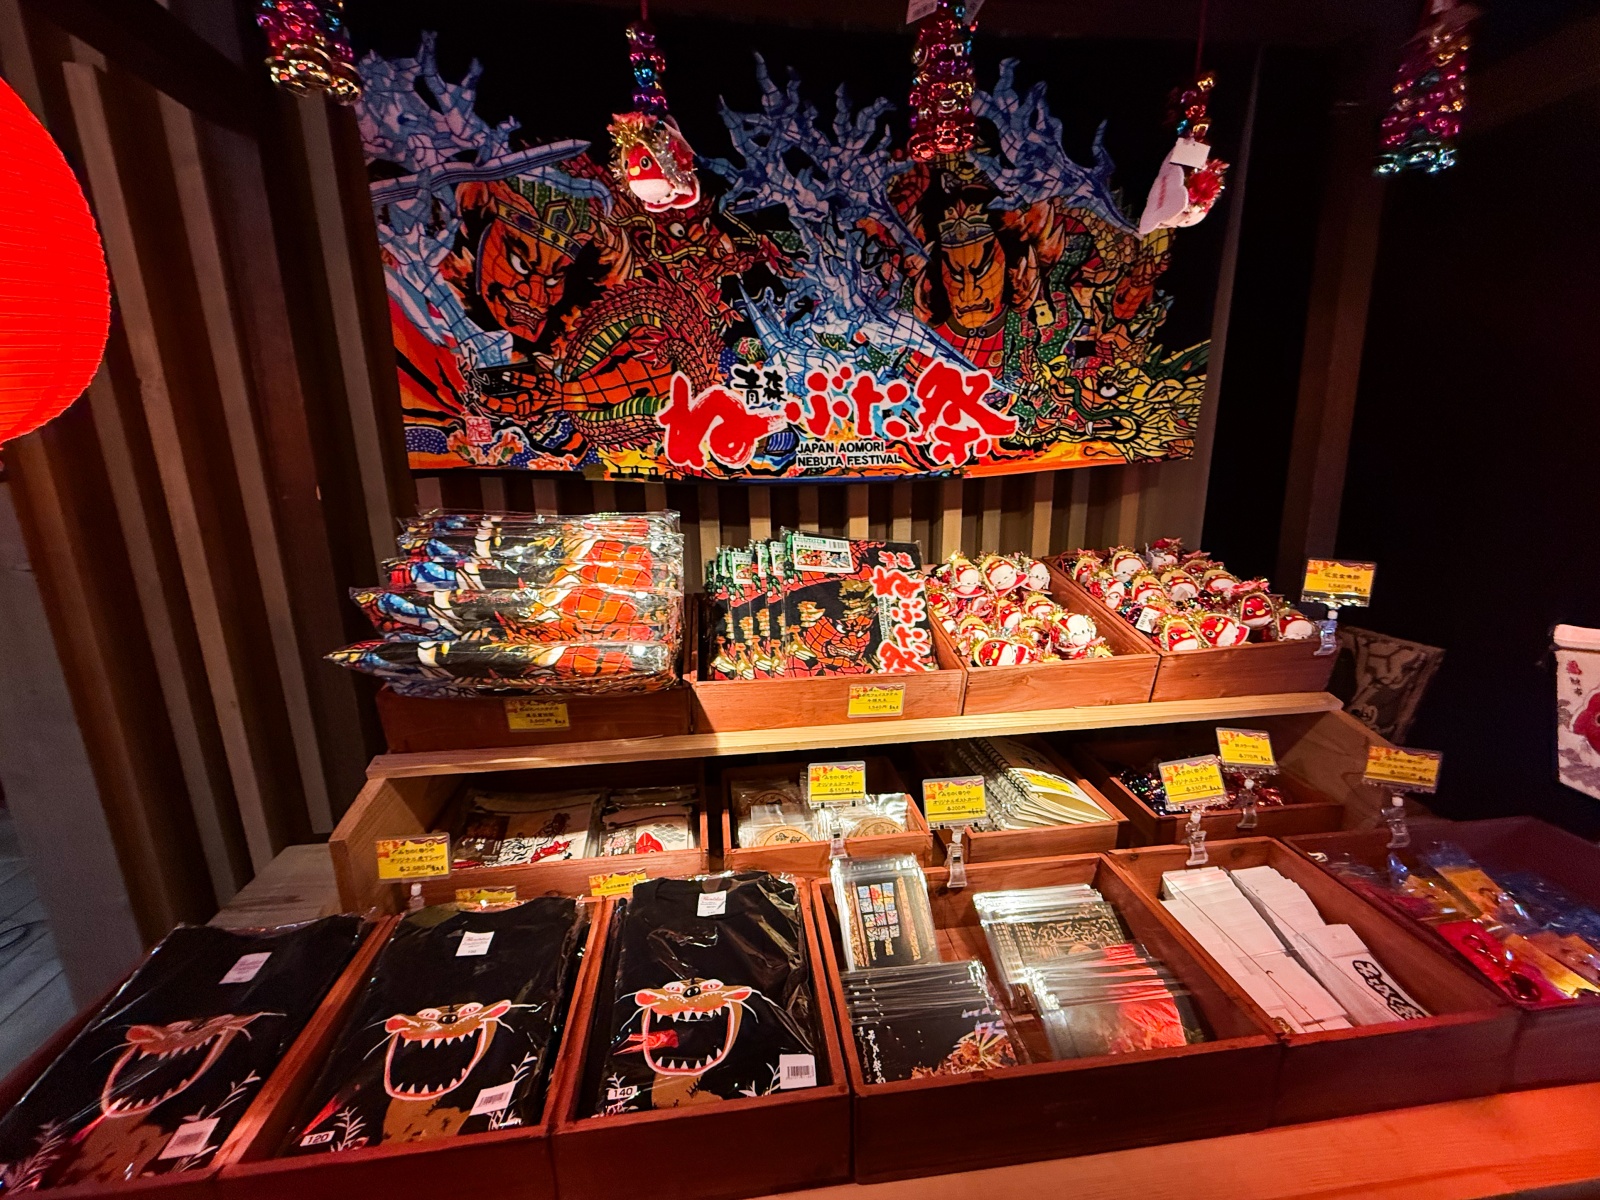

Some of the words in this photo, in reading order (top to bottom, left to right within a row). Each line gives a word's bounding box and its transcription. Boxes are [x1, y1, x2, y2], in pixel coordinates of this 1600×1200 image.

[734, 368, 787, 405] 青森
[659, 360, 1019, 468] ねぶた祭
[797, 443, 834, 454] JAPAN
[838, 442, 884, 453] AOMORI
[797, 456, 844, 467] NEBUTA
[846, 454, 902, 466] FESTIVAL
[614, 1087, 633, 1098] 140
[307, 1133, 330, 1144] 120
